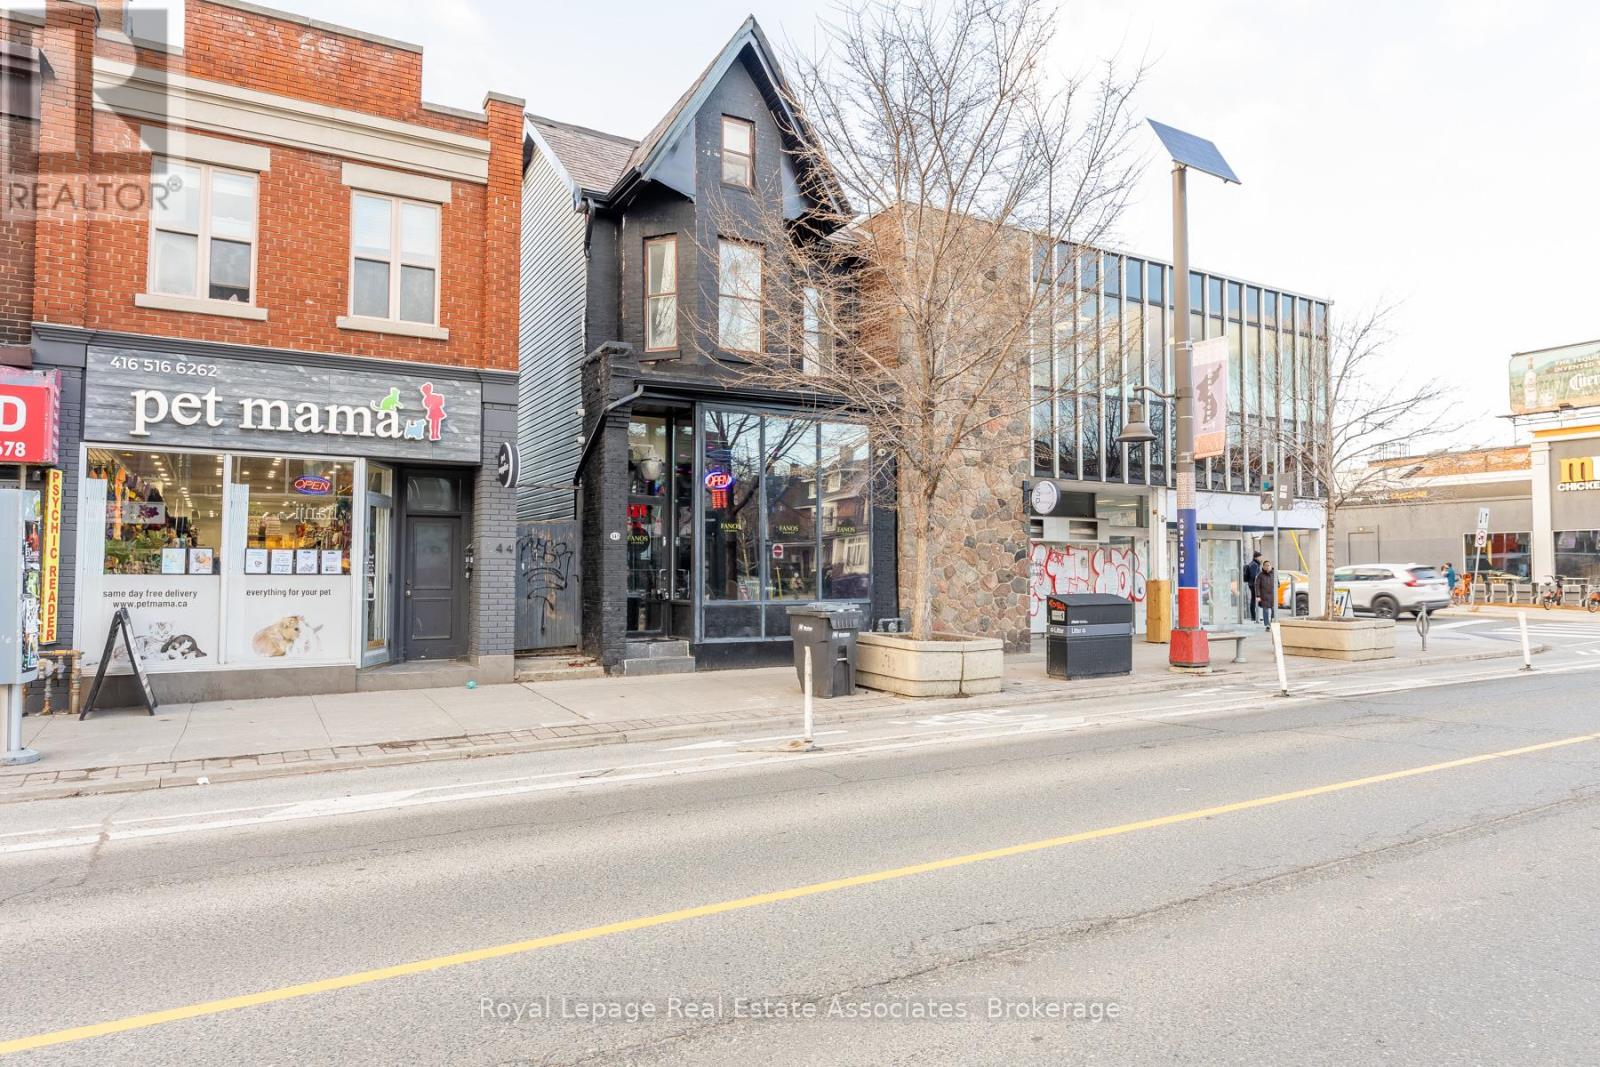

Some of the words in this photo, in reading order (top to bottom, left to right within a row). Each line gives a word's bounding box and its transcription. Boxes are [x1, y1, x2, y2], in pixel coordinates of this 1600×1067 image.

[110, 356, 139, 371] 416
[143, 360, 171, 373] 516
[176, 362, 217, 377] 6262
[129, 386, 224, 436] pet
[238, 397, 404, 439] mama
[294, 479, 330, 491] OPEN
[707, 474, 728, 487] OPEN
[50, 471, 60, 559] PSYCHIC
[102, 590, 127, 598] same
[128, 589, 144, 600] day
[145, 589, 164, 598] free
[165, 589, 198, 600] delivery
[246, 588, 287, 598] everything
[288, 588, 299, 597] for
[301, 589, 317, 598] your
[319, 588, 332, 597] pet
[46, 565, 57, 641] READER
